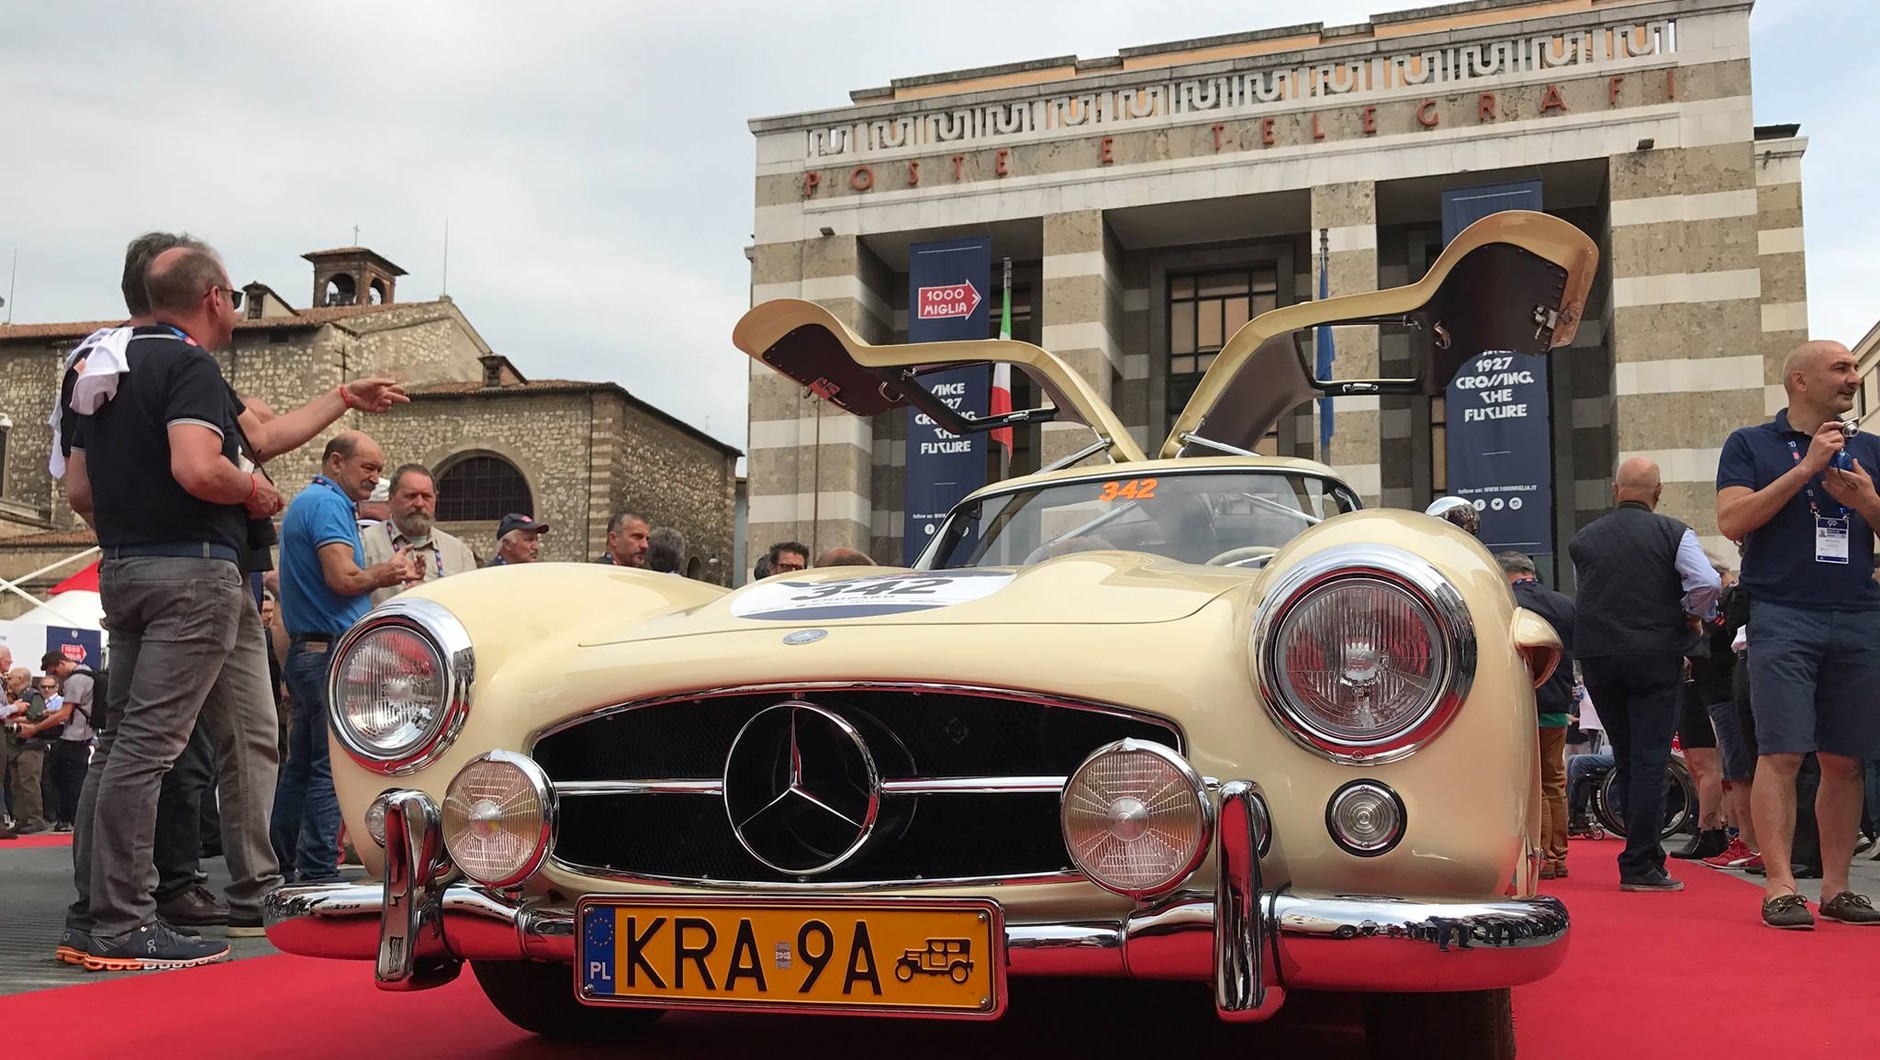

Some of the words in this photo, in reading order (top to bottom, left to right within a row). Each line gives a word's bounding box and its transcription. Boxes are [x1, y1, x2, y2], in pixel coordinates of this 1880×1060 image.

[804, 148, 1009, 197] POSTE
[1100, 136, 1115, 164] E
[1211, 69, 1676, 154] TELEGRAFI
[926, 288, 965, 302] 1000
[923, 302, 967, 317] MIGLIA
[1475, 357, 1514, 373] 1927
[1479, 389, 1513, 404] THE
[1464, 403, 1528, 423] FUTURE
[920, 440, 972, 455] FUTURE
[1099, 478, 1159, 502] 342
[791, 578, 954, 601] 342
[626, 915, 770, 993] KRA
[796, 918, 884, 997] 9A
[590, 960, 611, 981] PL
